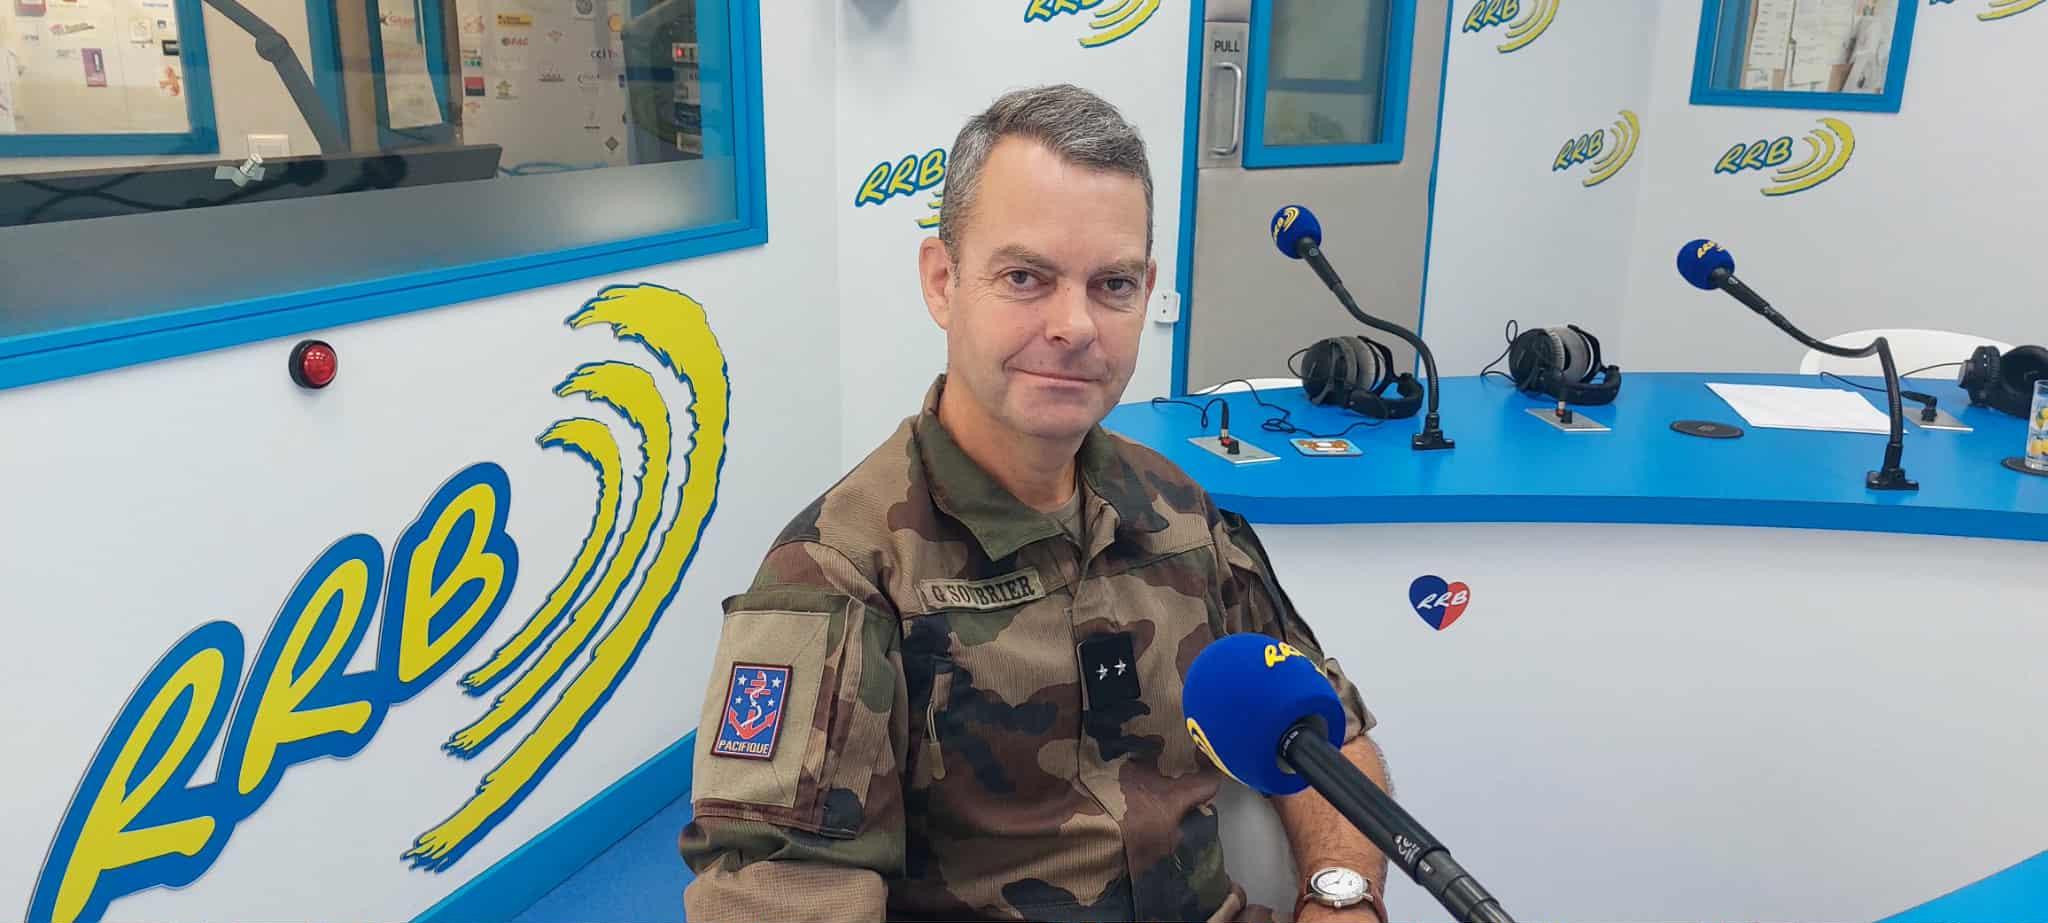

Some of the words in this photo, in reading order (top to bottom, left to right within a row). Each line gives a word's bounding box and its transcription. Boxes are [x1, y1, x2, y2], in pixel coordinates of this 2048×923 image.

[1214, 39, 1240, 53] PULL
[1552, 129, 1604, 172] RRB
[1714, 136, 1793, 174] RRB
[855, 148, 947, 208] RRB
[947, 575, 1035, 605] SOBRIER
[1416, 590, 1468, 610] RRB
[27, 462, 518, 923] RRB
[718, 740, 770, 754] PACIFIQUE
